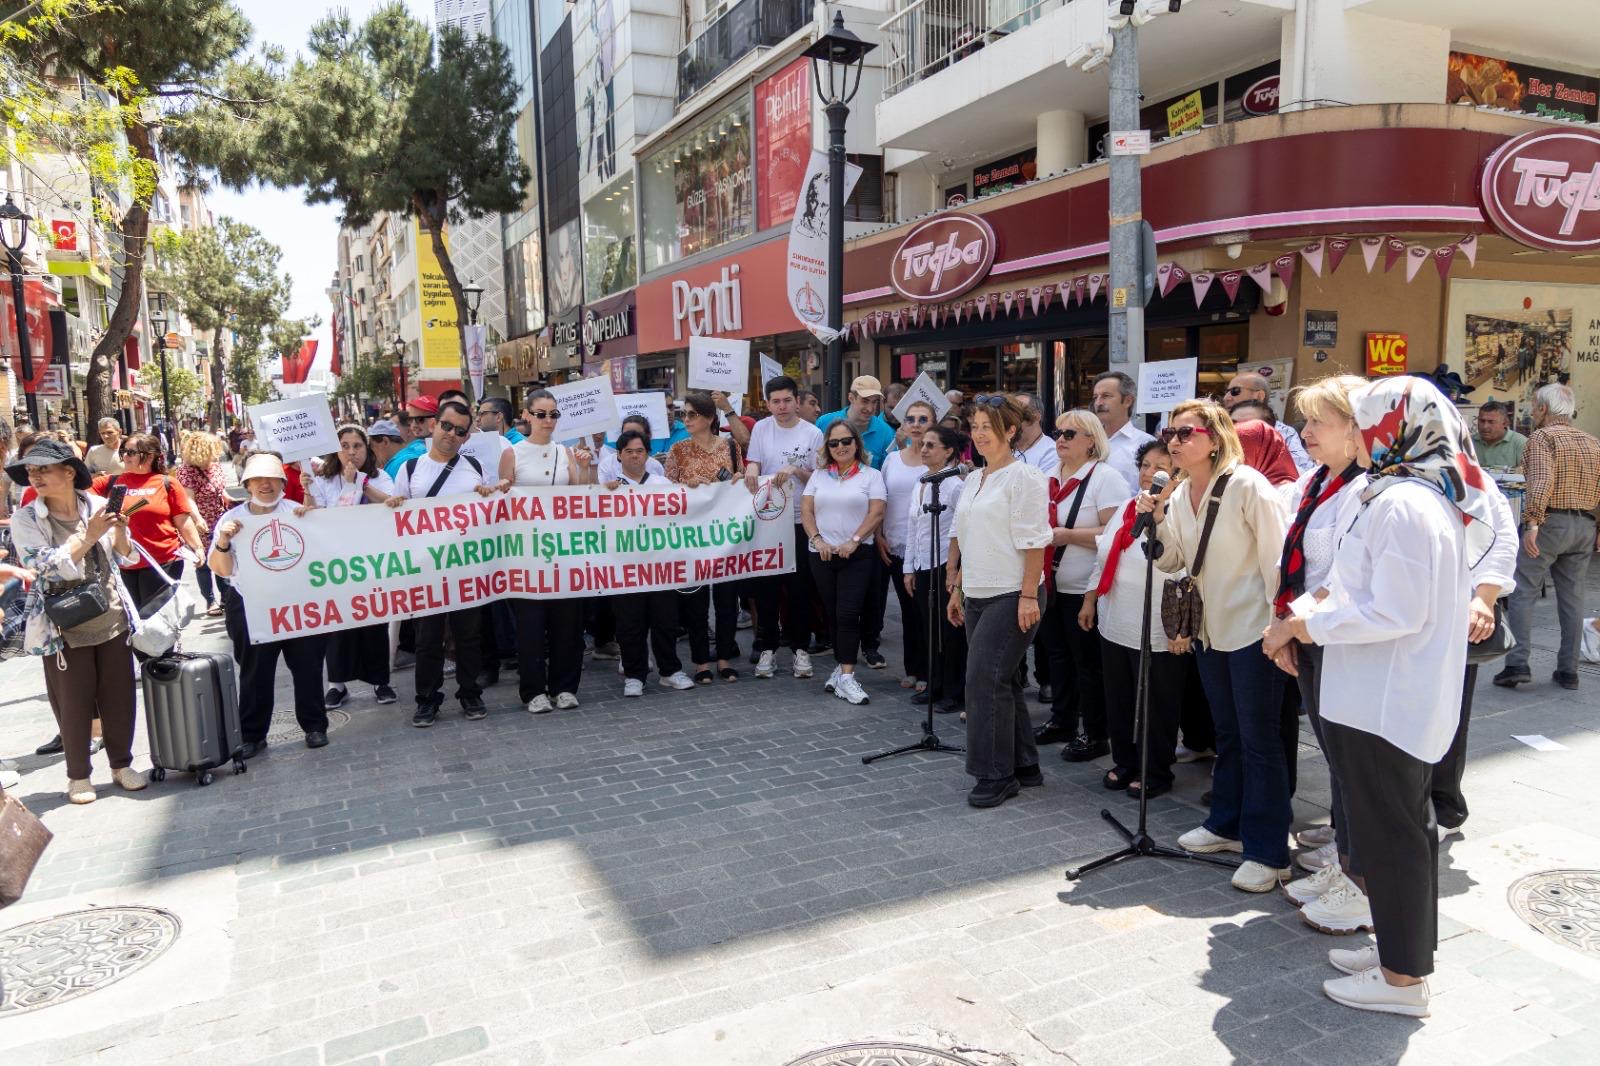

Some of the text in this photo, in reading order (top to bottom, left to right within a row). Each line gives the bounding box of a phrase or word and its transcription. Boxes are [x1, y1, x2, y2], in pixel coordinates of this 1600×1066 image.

[1528, 78, 1596, 106] Her Zaman
[672, 264, 742, 340] Penti
[555, 322, 576, 344] elmas
[582, 310, 629, 356] KOMPEDAN
[1369, 339, 1406, 363] WC
[1577, 349, 1600, 362] MAĞ
[394, 488, 688, 536] KARŞIYAKA BELEDİYESİ
[308, 515, 755, 588] SOSYAL YARDIM İŞLERİ MÜDÜRLÜĞÜ
[269, 542, 784, 635] KISA SÜRELİ ENGELLİ DİNLENME MERKEZİ
